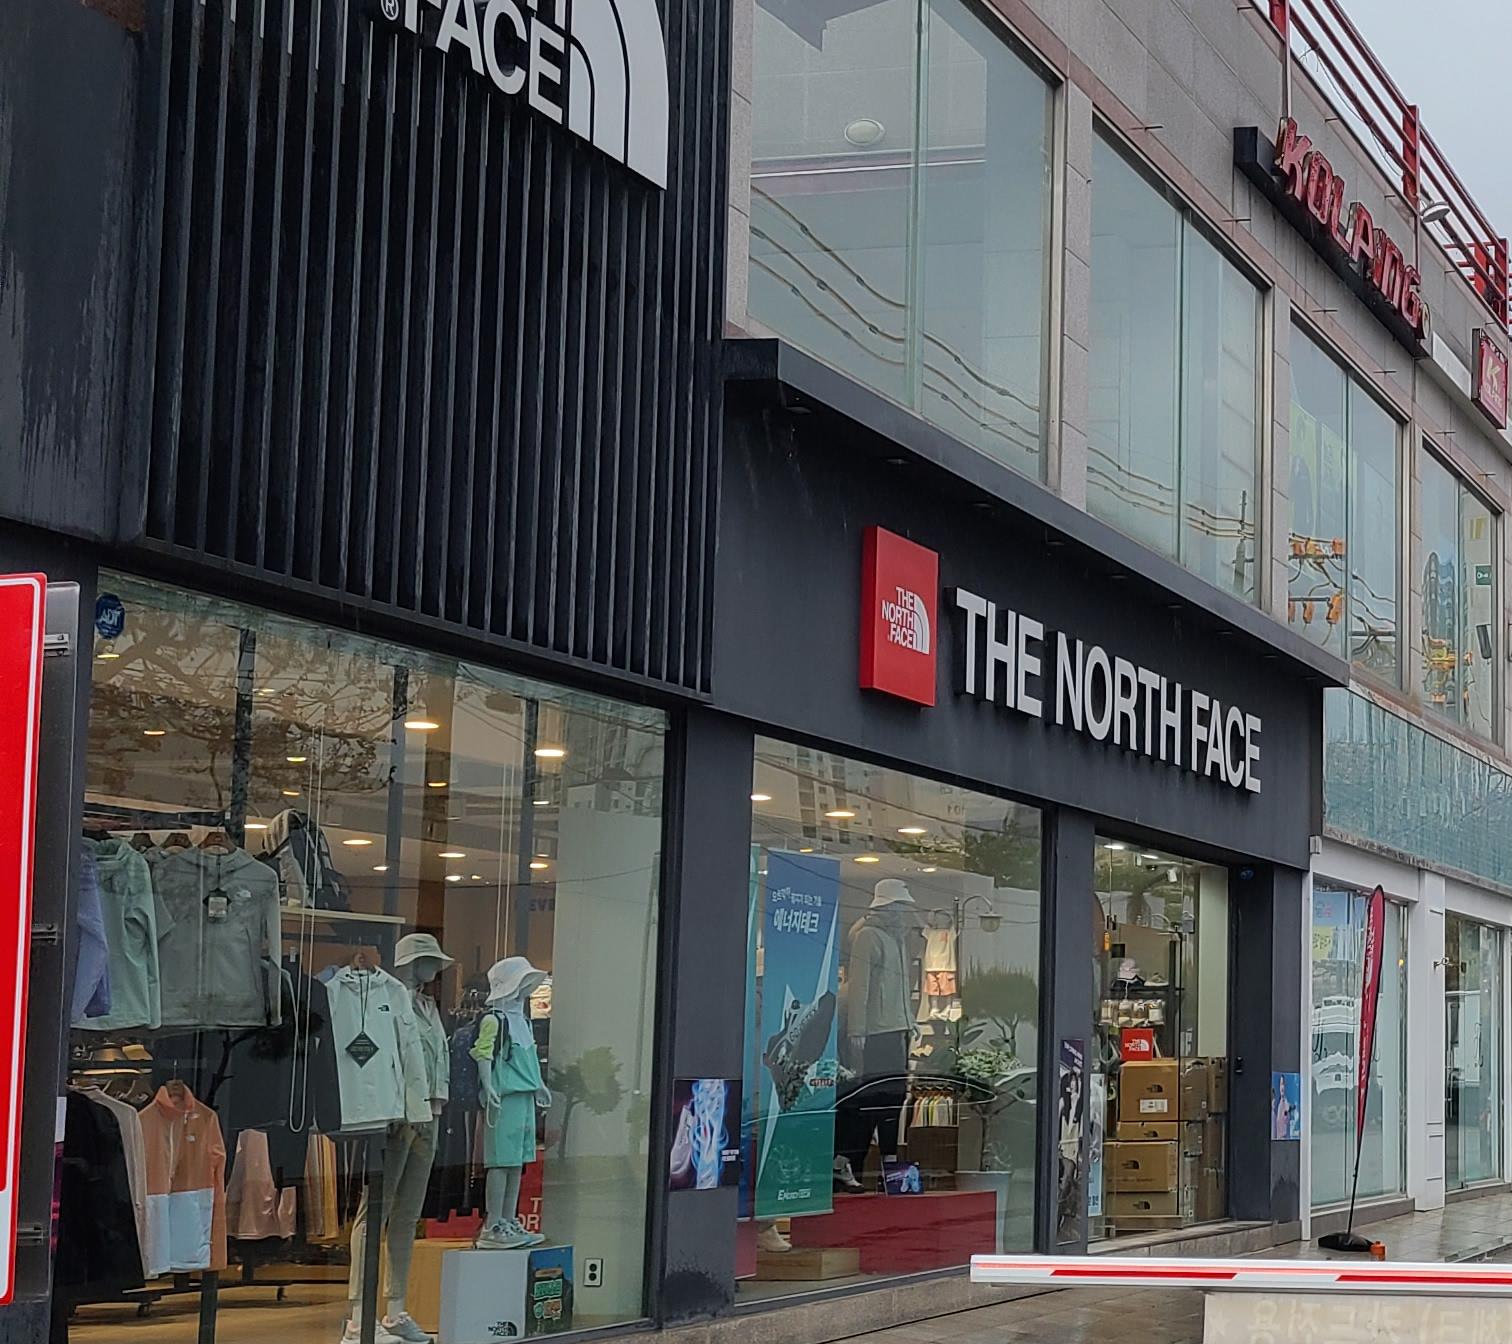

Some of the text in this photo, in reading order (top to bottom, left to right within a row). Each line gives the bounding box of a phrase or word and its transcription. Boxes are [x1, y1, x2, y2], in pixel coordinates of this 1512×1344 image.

[895, 586, 914, 610] THE
[881, 599, 914, 630] NORTH
[889, 622, 913, 649] FACE
[956, 587, 1262, 794] THE NORTH FACE
